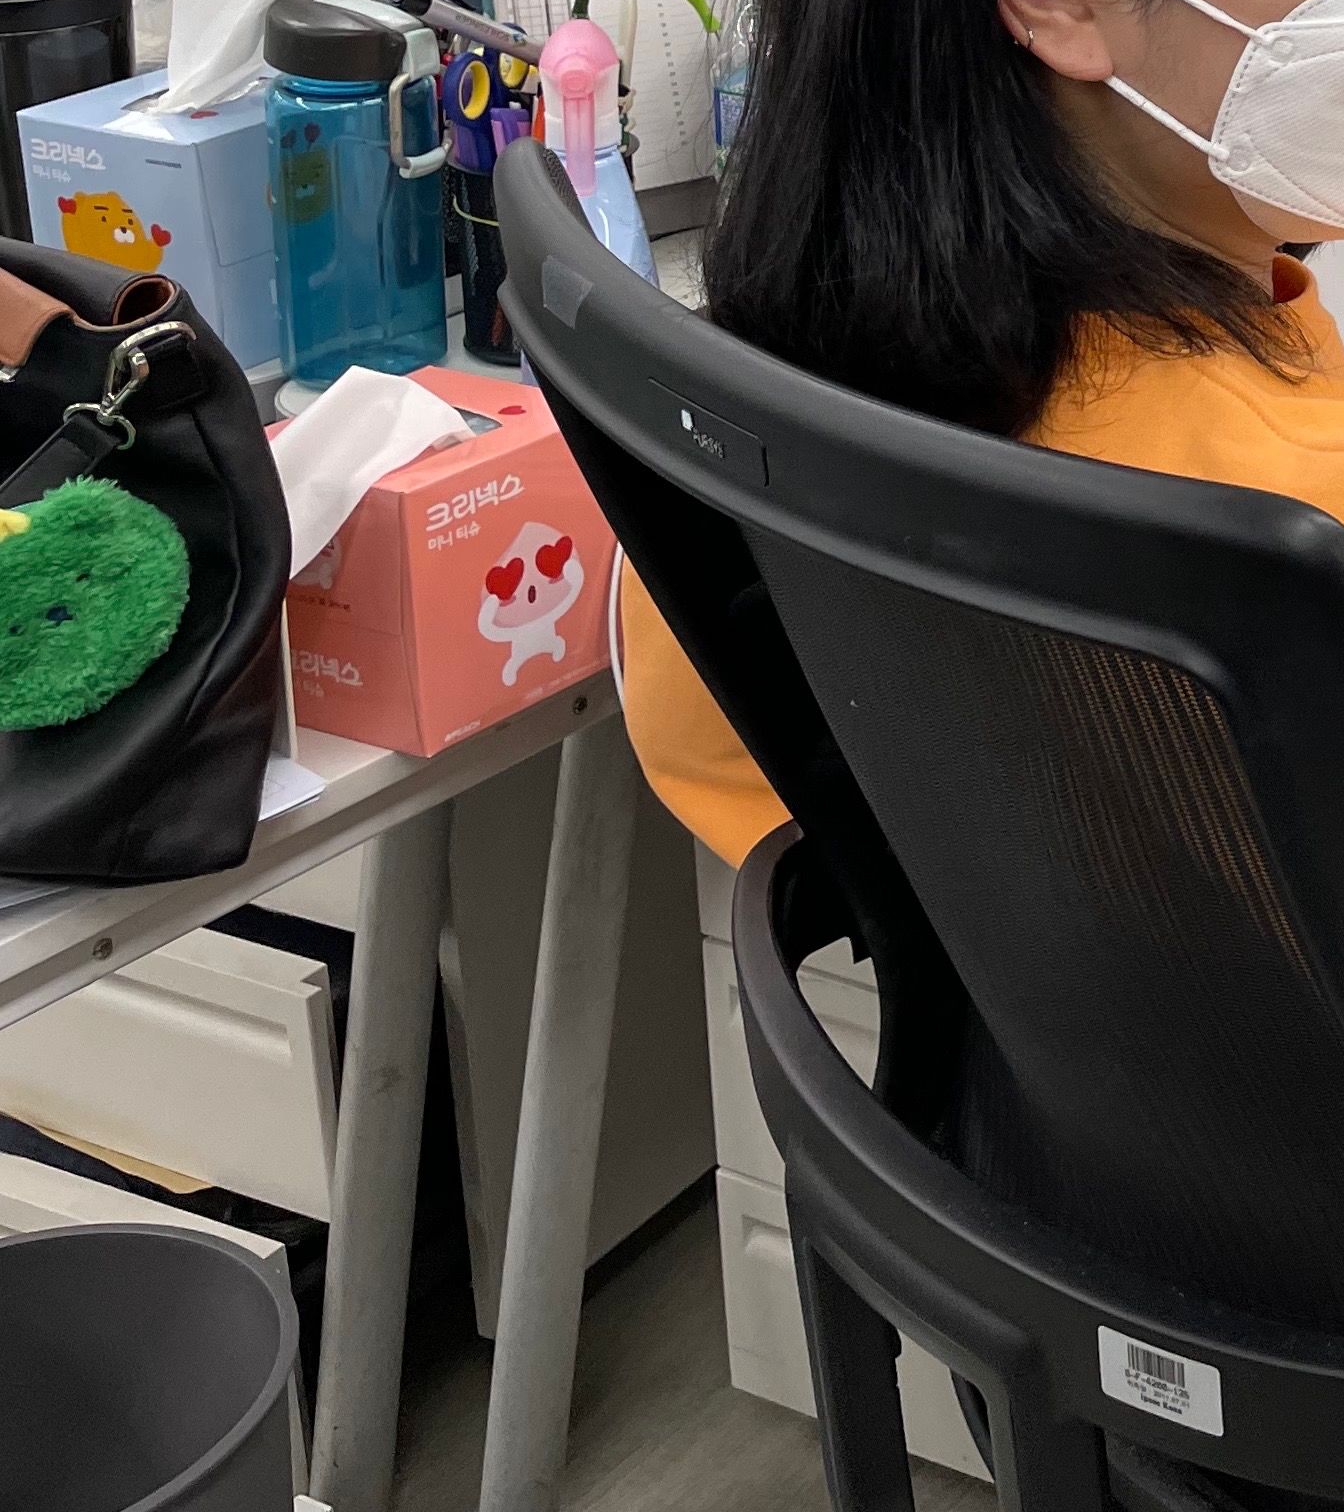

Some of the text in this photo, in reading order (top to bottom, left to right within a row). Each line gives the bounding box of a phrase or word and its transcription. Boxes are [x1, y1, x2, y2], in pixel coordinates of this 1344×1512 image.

[31, 137, 107, 170] 크리넥스
[425, 473, 527, 532] 크리넥스
[427, 521, 481, 551] 미니 티슈
